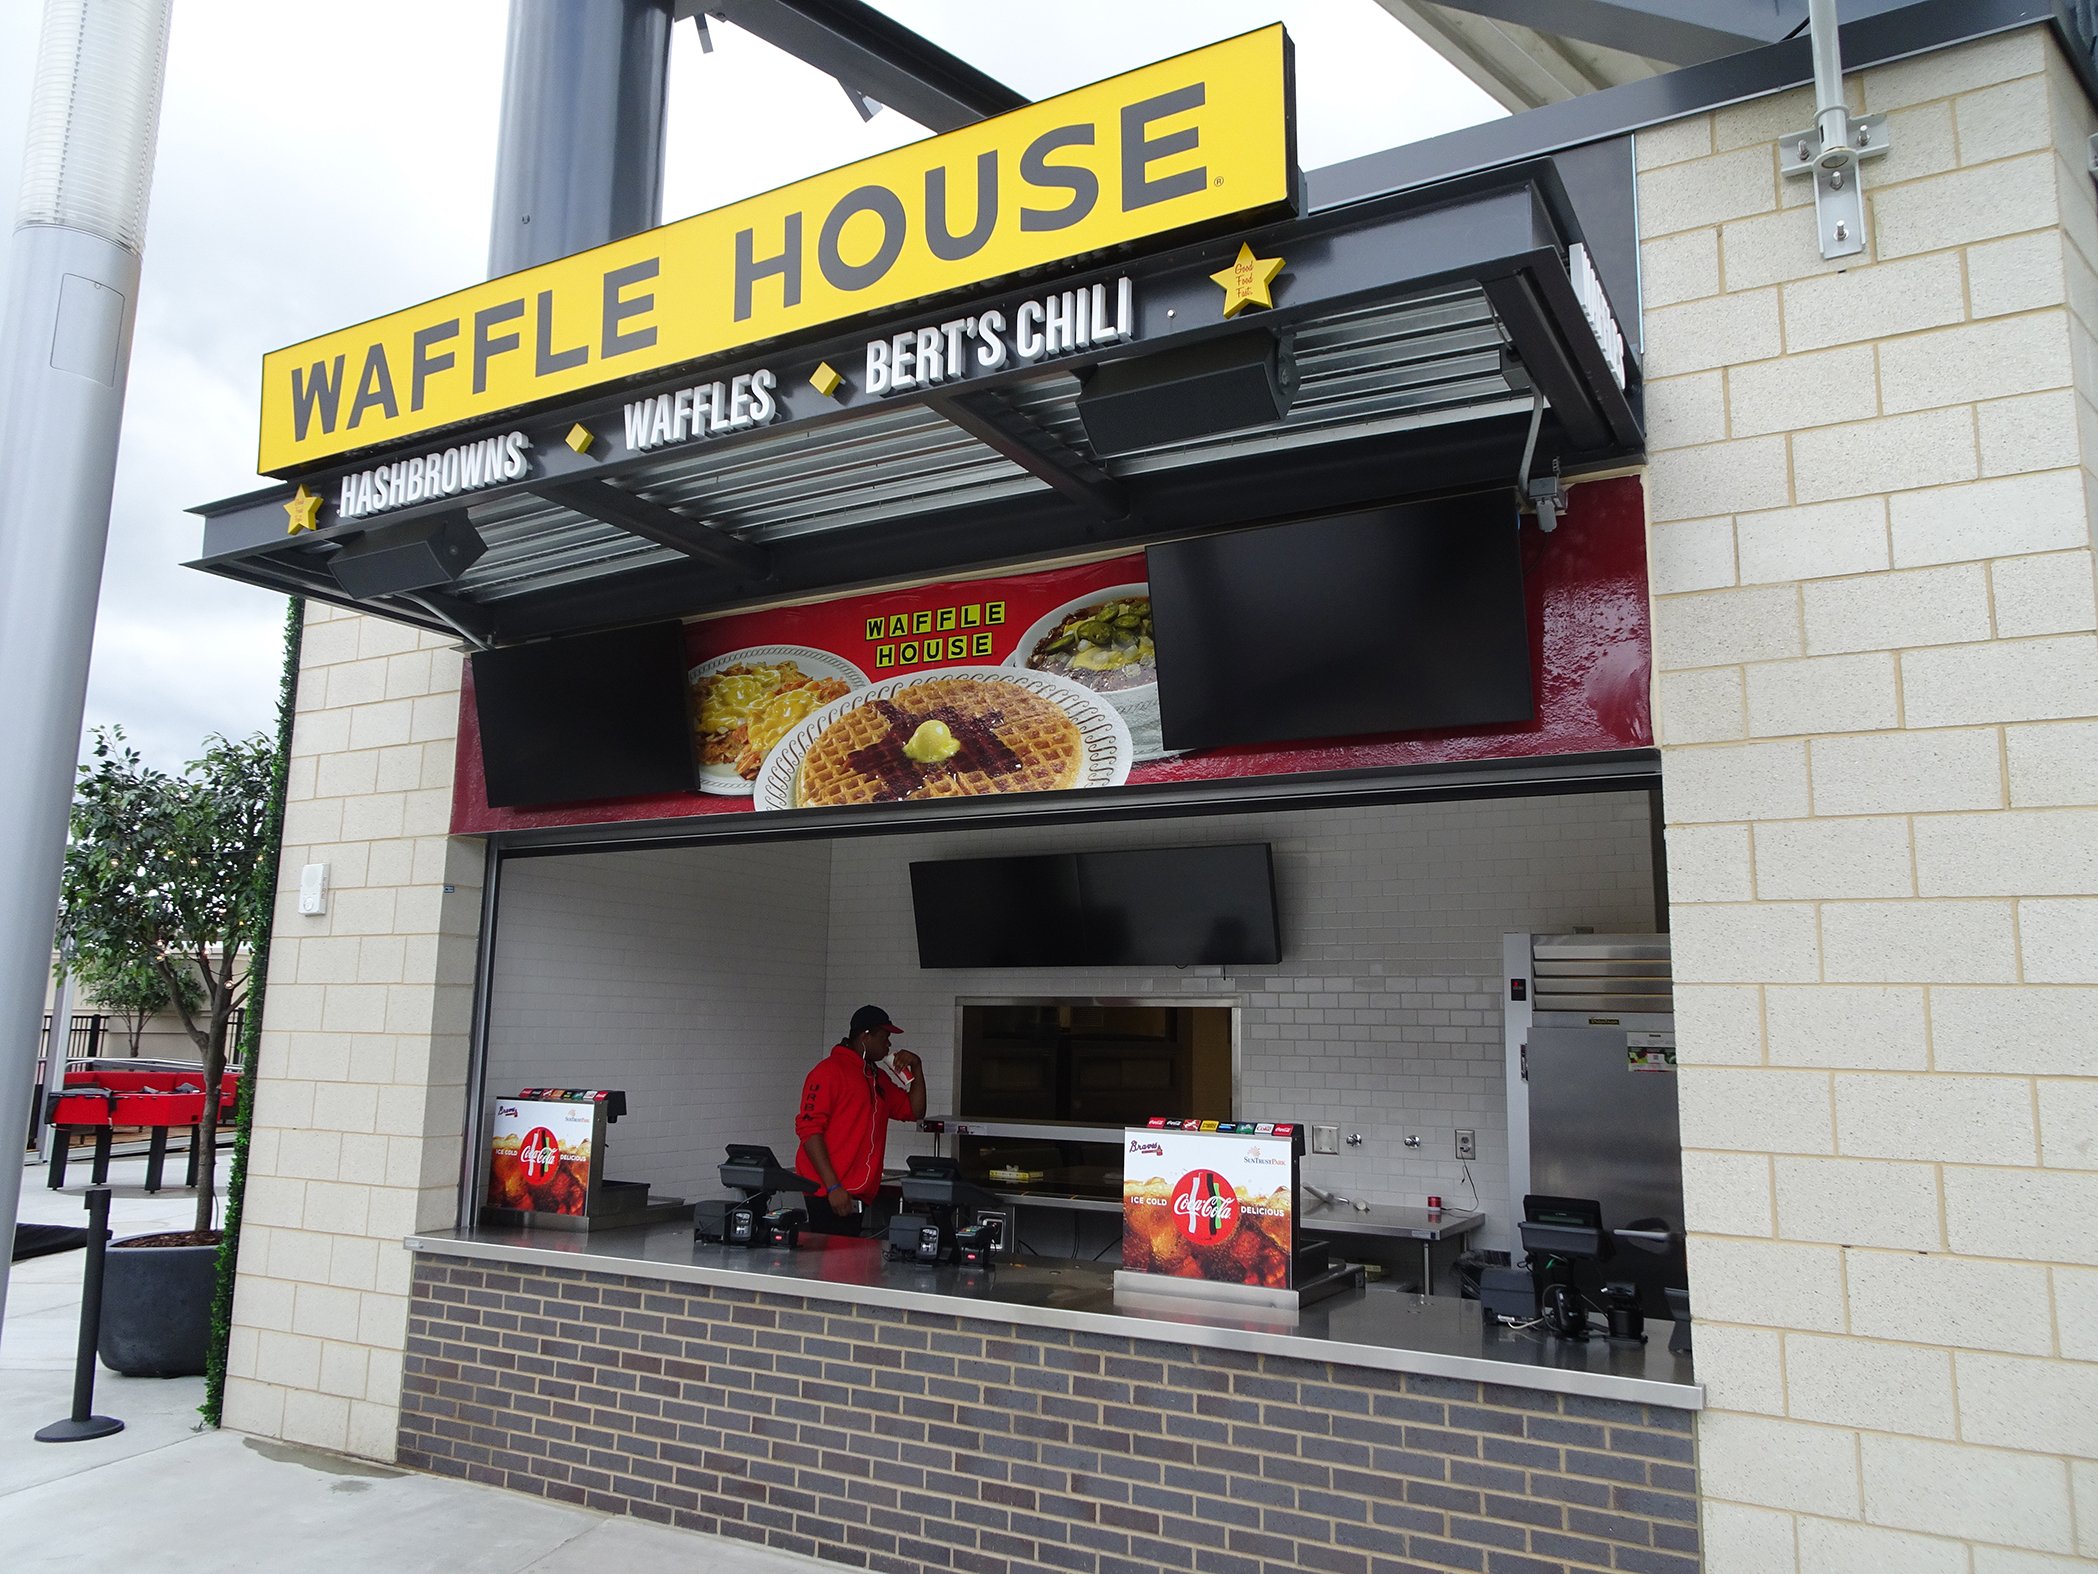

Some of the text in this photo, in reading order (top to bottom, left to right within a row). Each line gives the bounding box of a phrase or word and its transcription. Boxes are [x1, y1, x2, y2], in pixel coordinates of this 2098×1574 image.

[291, 256, 660, 443] WAFFLE
[732, 81, 1207, 322] HOUSE
[1235, 261, 1254, 274] Good
[1236, 273, 1253, 287] Food
[865, 275, 1133, 397] BERT'S CHILI
[623, 367, 777, 453] WAFFLES
[339, 429, 531, 519] HASHBROWNS
[867, 602, 1004, 639] WAFFLE
[877, 633, 992, 667] HOUSE
[520, 1145, 558, 1165] Coca-Cola
[560, 1154, 587, 1162] DELICIOUS
[1130, 1196, 1168, 1206] ICE COLD
[1173, 1192, 1236, 1220] Coca-Cola
[1240, 1205, 1285, 1217] DELICIOUS
